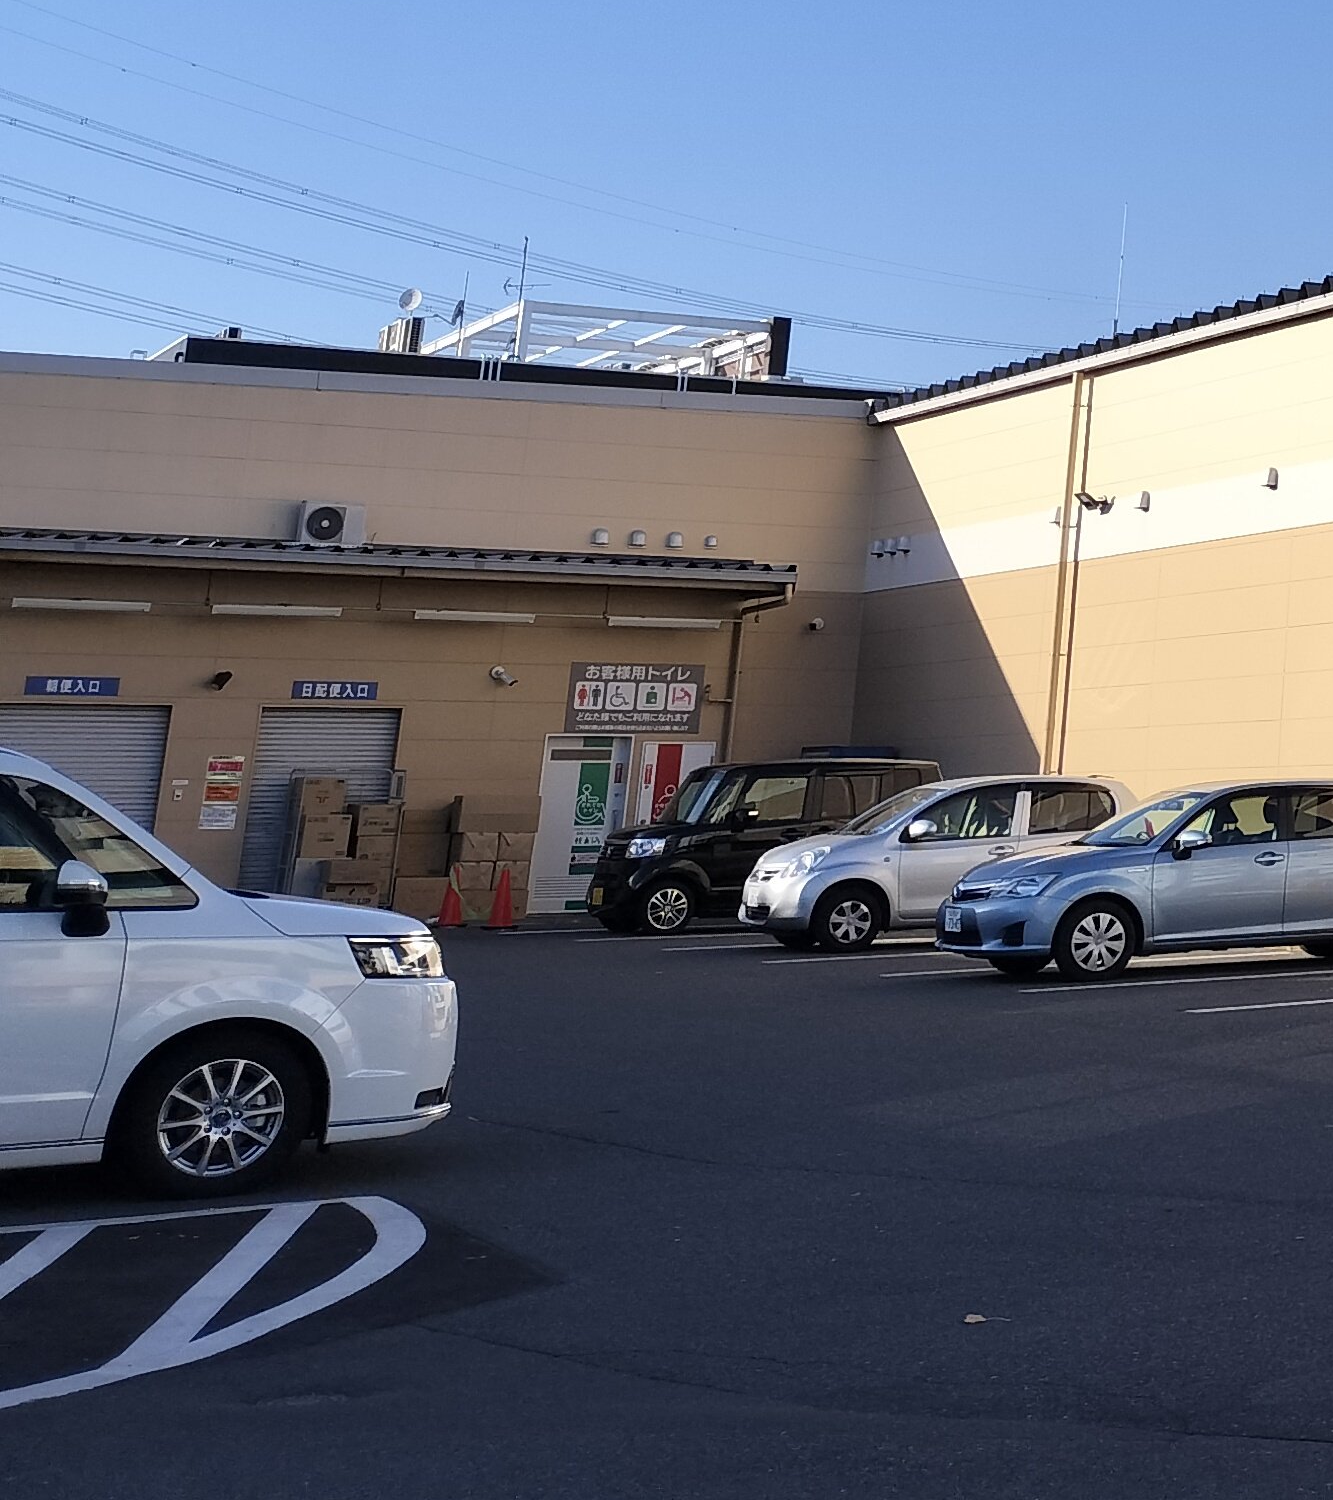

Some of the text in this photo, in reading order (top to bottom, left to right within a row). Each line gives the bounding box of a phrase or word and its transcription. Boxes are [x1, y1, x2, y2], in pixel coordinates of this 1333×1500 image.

[585, 664, 691, 680] お客様用トイレ
[302, 683, 369, 698] 日配便入口
